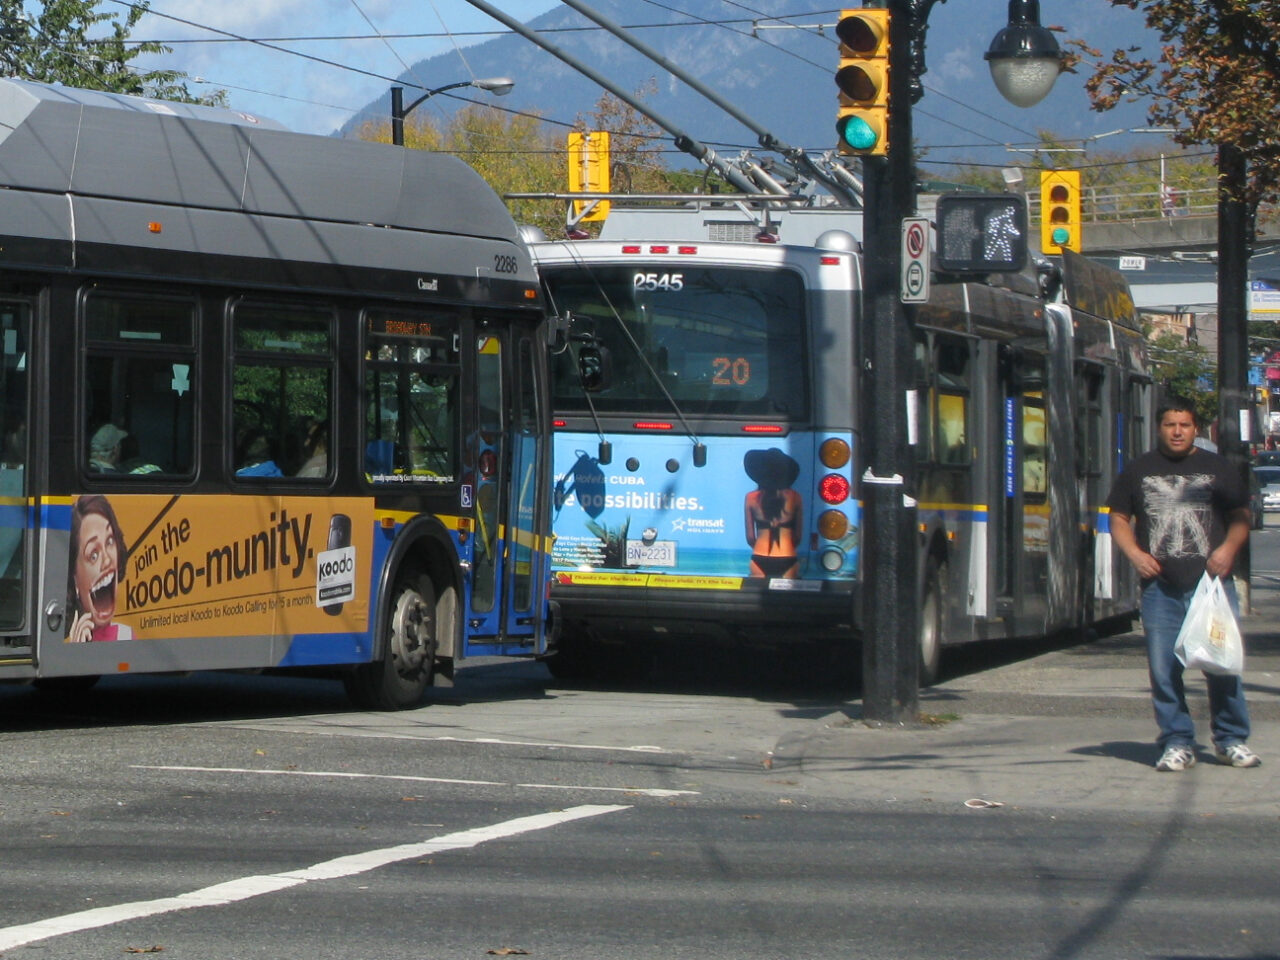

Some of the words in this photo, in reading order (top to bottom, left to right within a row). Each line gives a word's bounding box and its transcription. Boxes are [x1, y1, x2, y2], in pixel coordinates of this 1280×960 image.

[494, 254, 518, 274] 2286
[633, 273, 684, 292] 2545
[712, 357, 750, 385] 20
[610, 475, 645, 485] CUBA
[581, 491, 704, 512] possibilities.
[687, 518, 724, 528] transat
[126, 509, 314, 611] koodo-munity.
[135, 543, 158, 578] join
[161, 518, 191, 555] the
[319, 553, 353, 581] koodo
[139, 612, 171, 630] Unlimited
[172, 611, 190, 624] local
[190, 608, 213, 622] Koodo
[214, 607, 221, 618] to
[222, 604, 244, 617] Koodo
[245, 600, 267, 614] Calling
[286, 598, 291, 607] a
